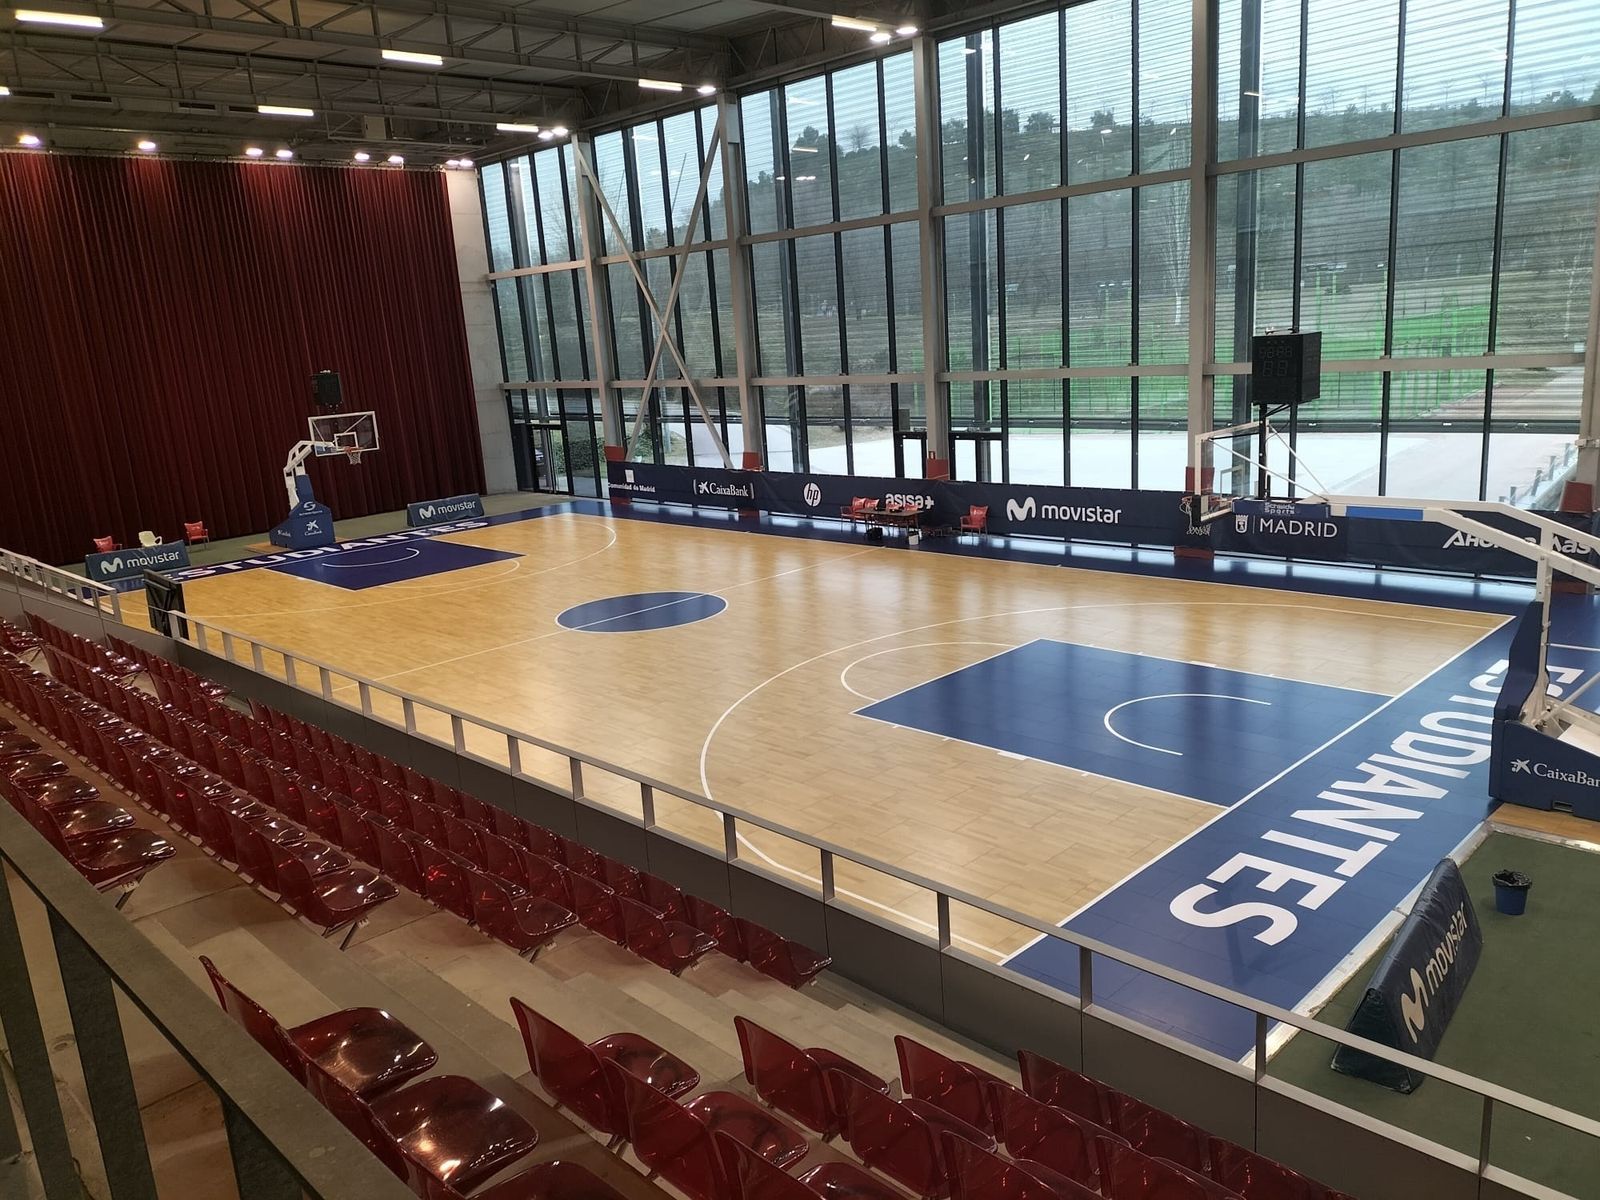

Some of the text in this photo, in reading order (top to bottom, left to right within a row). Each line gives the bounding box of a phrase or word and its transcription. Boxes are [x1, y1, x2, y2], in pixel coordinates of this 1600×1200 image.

[709, 482, 749, 497] CaixaBank
[806, 483, 820, 505] hp
[437, 501, 476, 514] movistar
[1041, 504, 1122, 524] movistar
[1259, 518, 1338, 538] MADRID
[126, 551, 179, 568] movistar
[1425, 901, 1468, 996] movistar
